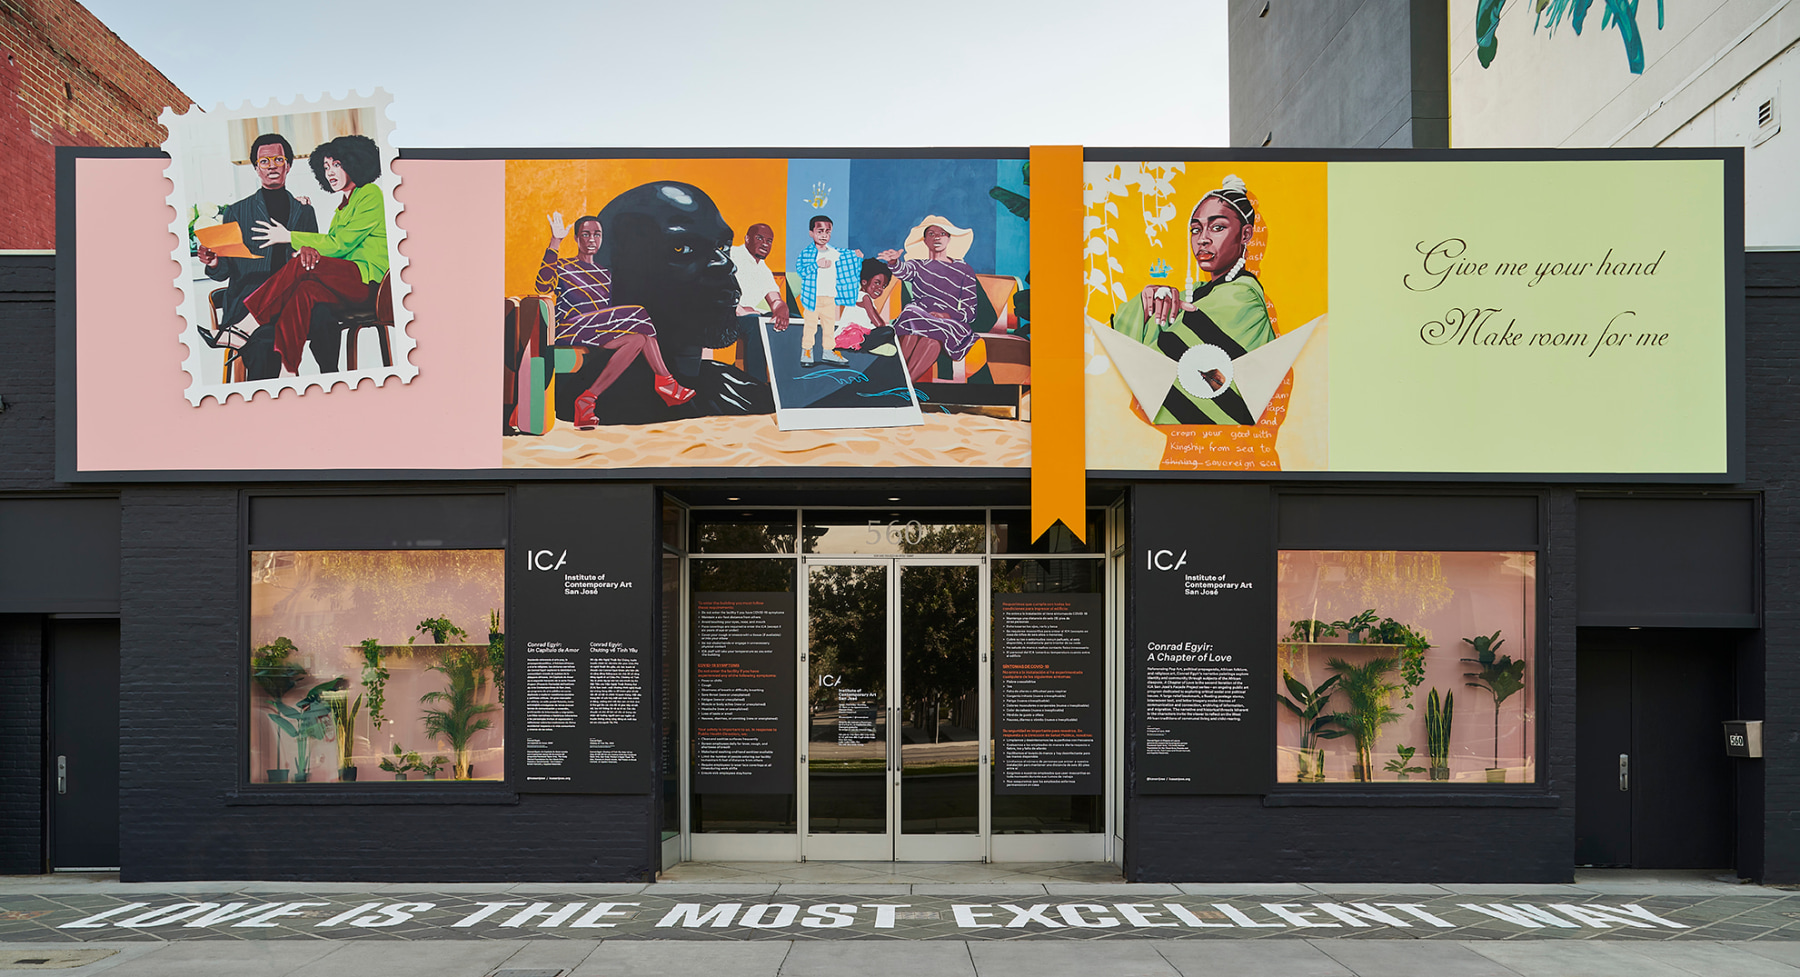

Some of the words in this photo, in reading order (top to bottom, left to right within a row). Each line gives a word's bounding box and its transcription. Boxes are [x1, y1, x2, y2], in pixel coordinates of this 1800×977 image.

[1404, 238, 1488, 292] Give
[1495, 262, 1528, 276] me
[1528, 262, 1592, 288] your
[1596, 248, 1666, 276] hand
[1420, 308, 1523, 346] Make
[1528, 332, 1589, 346] room
[1588, 310, 1636, 358] for
[1636, 332, 1670, 346] me
[1260, 417, 1277, 425] and
[1231, 430, 1250, 440] good
[1253, 430, 1272, 439] with
[1209, 442, 1230, 452] from
[1260, 444, 1271, 453] to
[1205, 460, 1254, 470] sovereign
[866, 520, 922, 545] 560
[527, 549, 568, 571] ICA
[1147, 549, 1187, 571] ICA
[1147, 642, 1183, 651] Conrad
[1185, 642, 1213, 653] Egyir:
[1147, 653, 1155, 662] A
[1157, 653, 1196, 664] Chapter
[1197, 653, 1208, 662] of
[819, 674, 842, 686] ICA
[1732, 736, 1743, 745] 560
[56, 901, 331, 928] LOVE
[314, 901, 436, 928] IS
[450, 902, 642, 928] THE
[655, 903, 912, 929] MOST
[950, 903, 1455, 929] EXCELLENT
[1458, 903, 1691, 929] WAY
